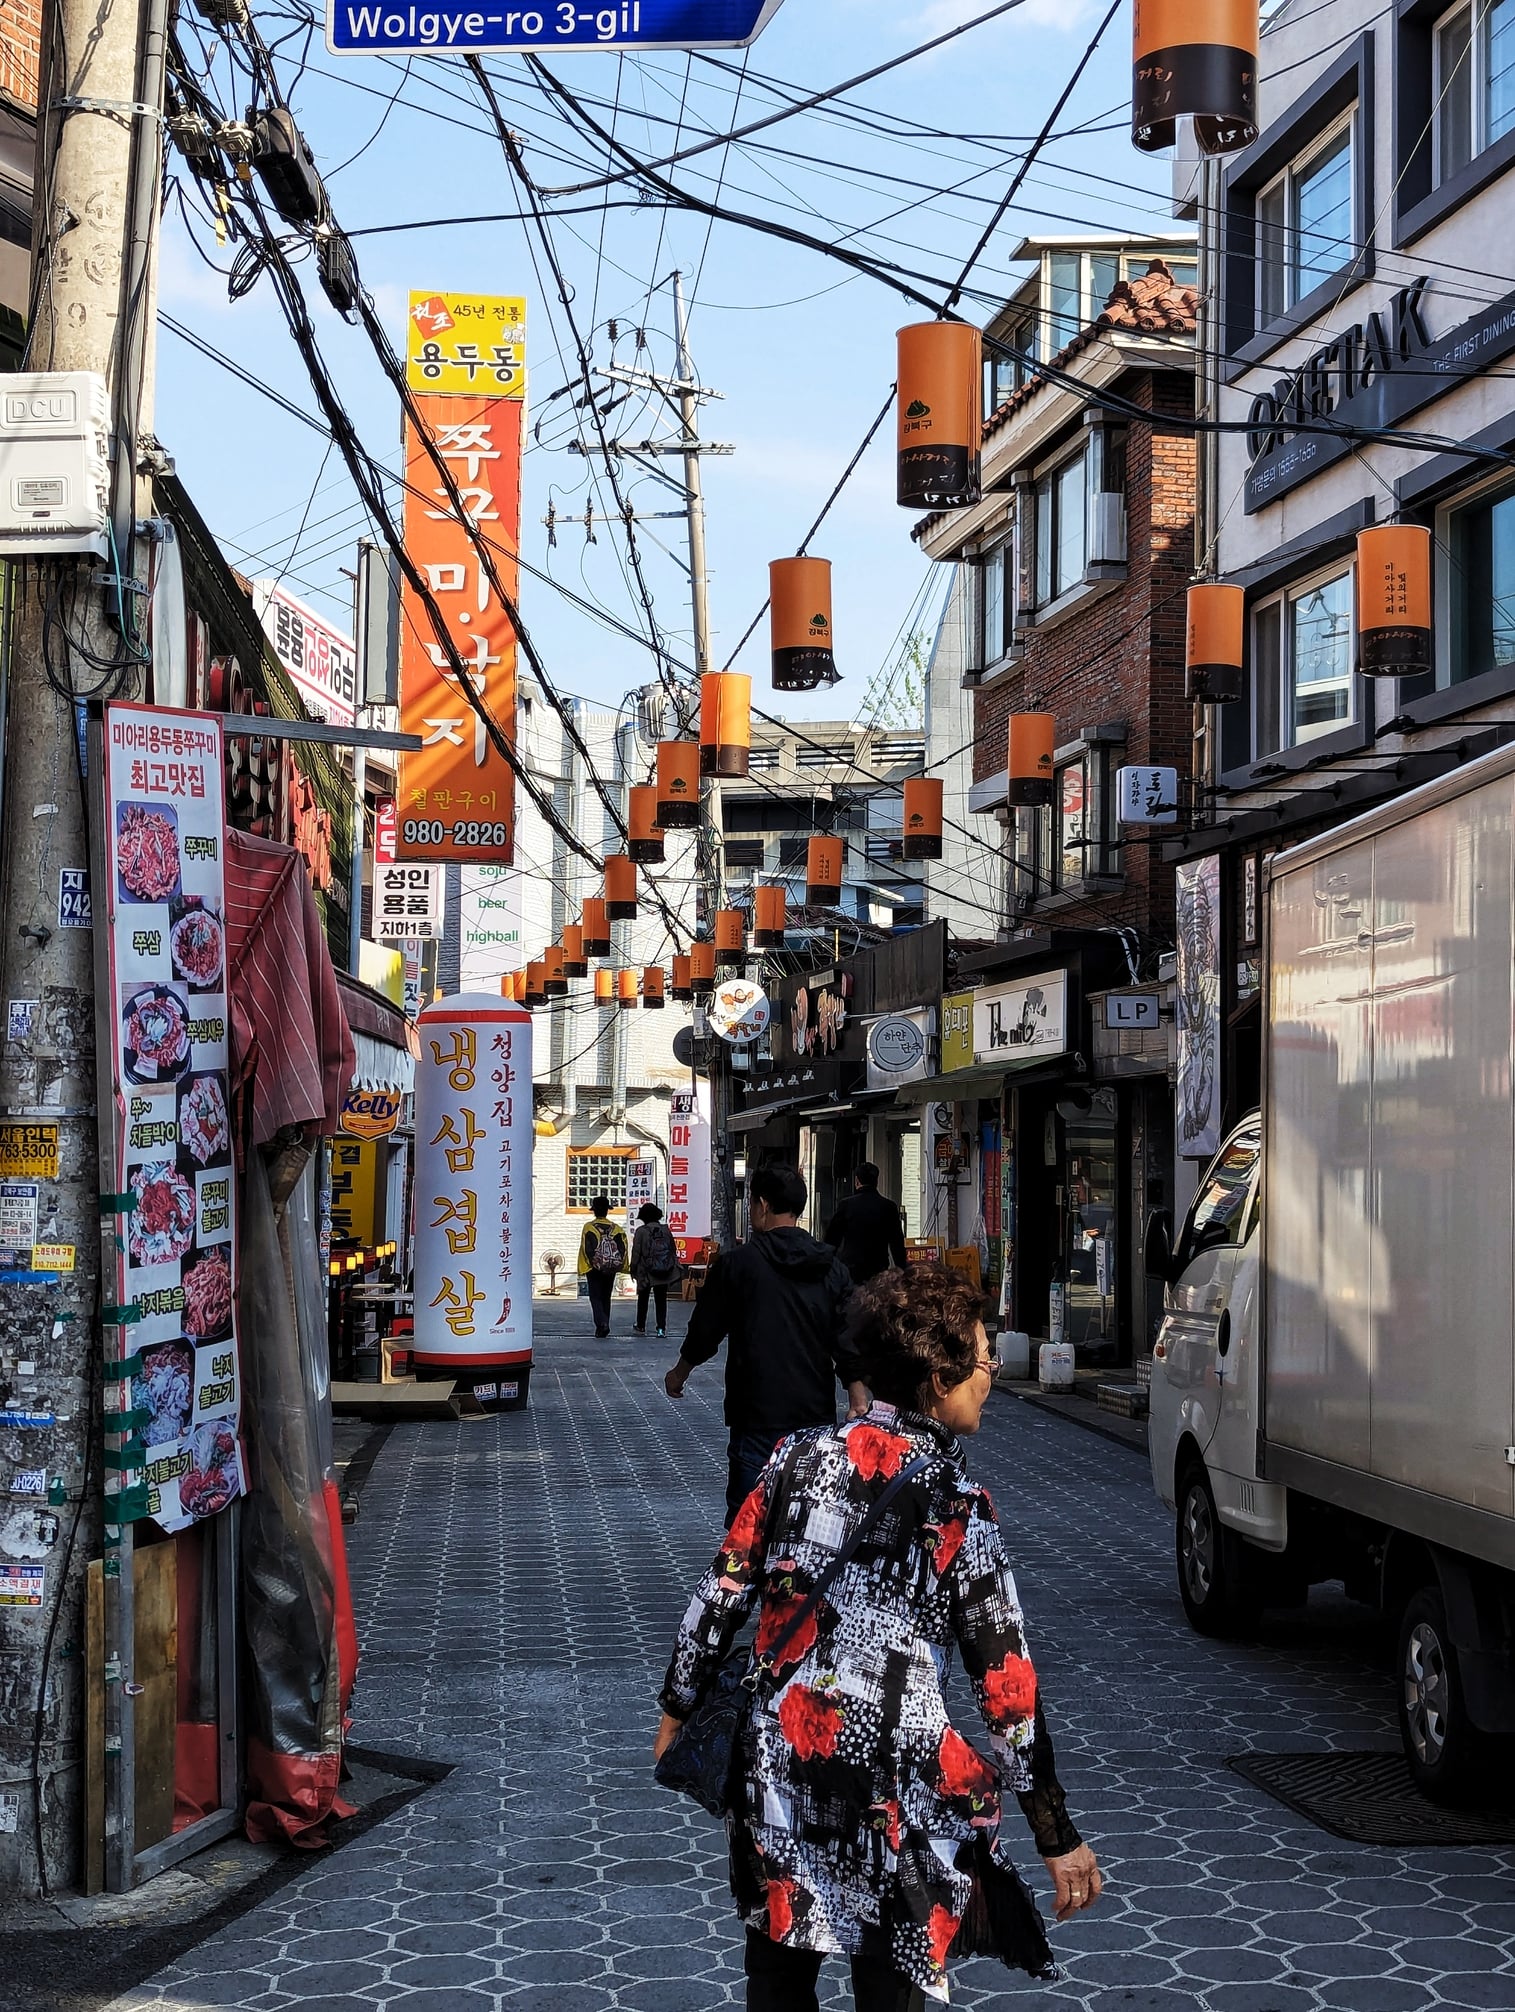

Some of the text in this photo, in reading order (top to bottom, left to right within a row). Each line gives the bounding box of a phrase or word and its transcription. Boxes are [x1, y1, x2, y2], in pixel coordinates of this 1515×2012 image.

[347, 2, 640, 45] Wolgye-ro 3-gil
[409, 301, 452, 331] 원조
[453, 304, 521, 321] 45년 전통
[1453, 333, 1480, 361] FIRST
[1482, 310, 1515, 345] DINING
[413, 342, 521, 383] 용두동
[1247, 275, 1434, 462] ONETAK
[11, 398, 63, 419] DCU
[112, 721, 217, 759] 미아리용두동쭈꾸미
[130, 760, 205, 798] 최고맛집
[410, 787, 497, 812] 철판구이
[403, 819, 507, 846] 980-2826
[185, 836, 218, 861] 쭈꾸미
[383, 869, 430, 890] 성인
[478, 866, 508, 879] soju
[383, 894, 430, 915] 용품
[478, 897, 508, 909] beer
[380, 921, 433, 936] 지하1층
[466, 930, 519, 945] highball
[133, 930, 161, 956] 쭈삼
[1117, 1002, 1148, 1020] LP
[884, 1029, 907, 1042] 하얀
[490, 1030, 515, 1128] 청양집
[341, 1095, 400, 1121] Kelly
[0, 1127, 57, 1143] 서울인력
[130, 1121, 181, 1149] 차돌박이
[201, 1177, 230, 1203] 쭈꾸미
[430, 1028, 487, 1336] 냉삼겹살
[669, 1125, 691, 1233] 마늘보쌈
[202, 1204, 230, 1234] 불고기
[212, 1352, 235, 1379] 낙지
[199, 1377, 235, 1411] 불고기
